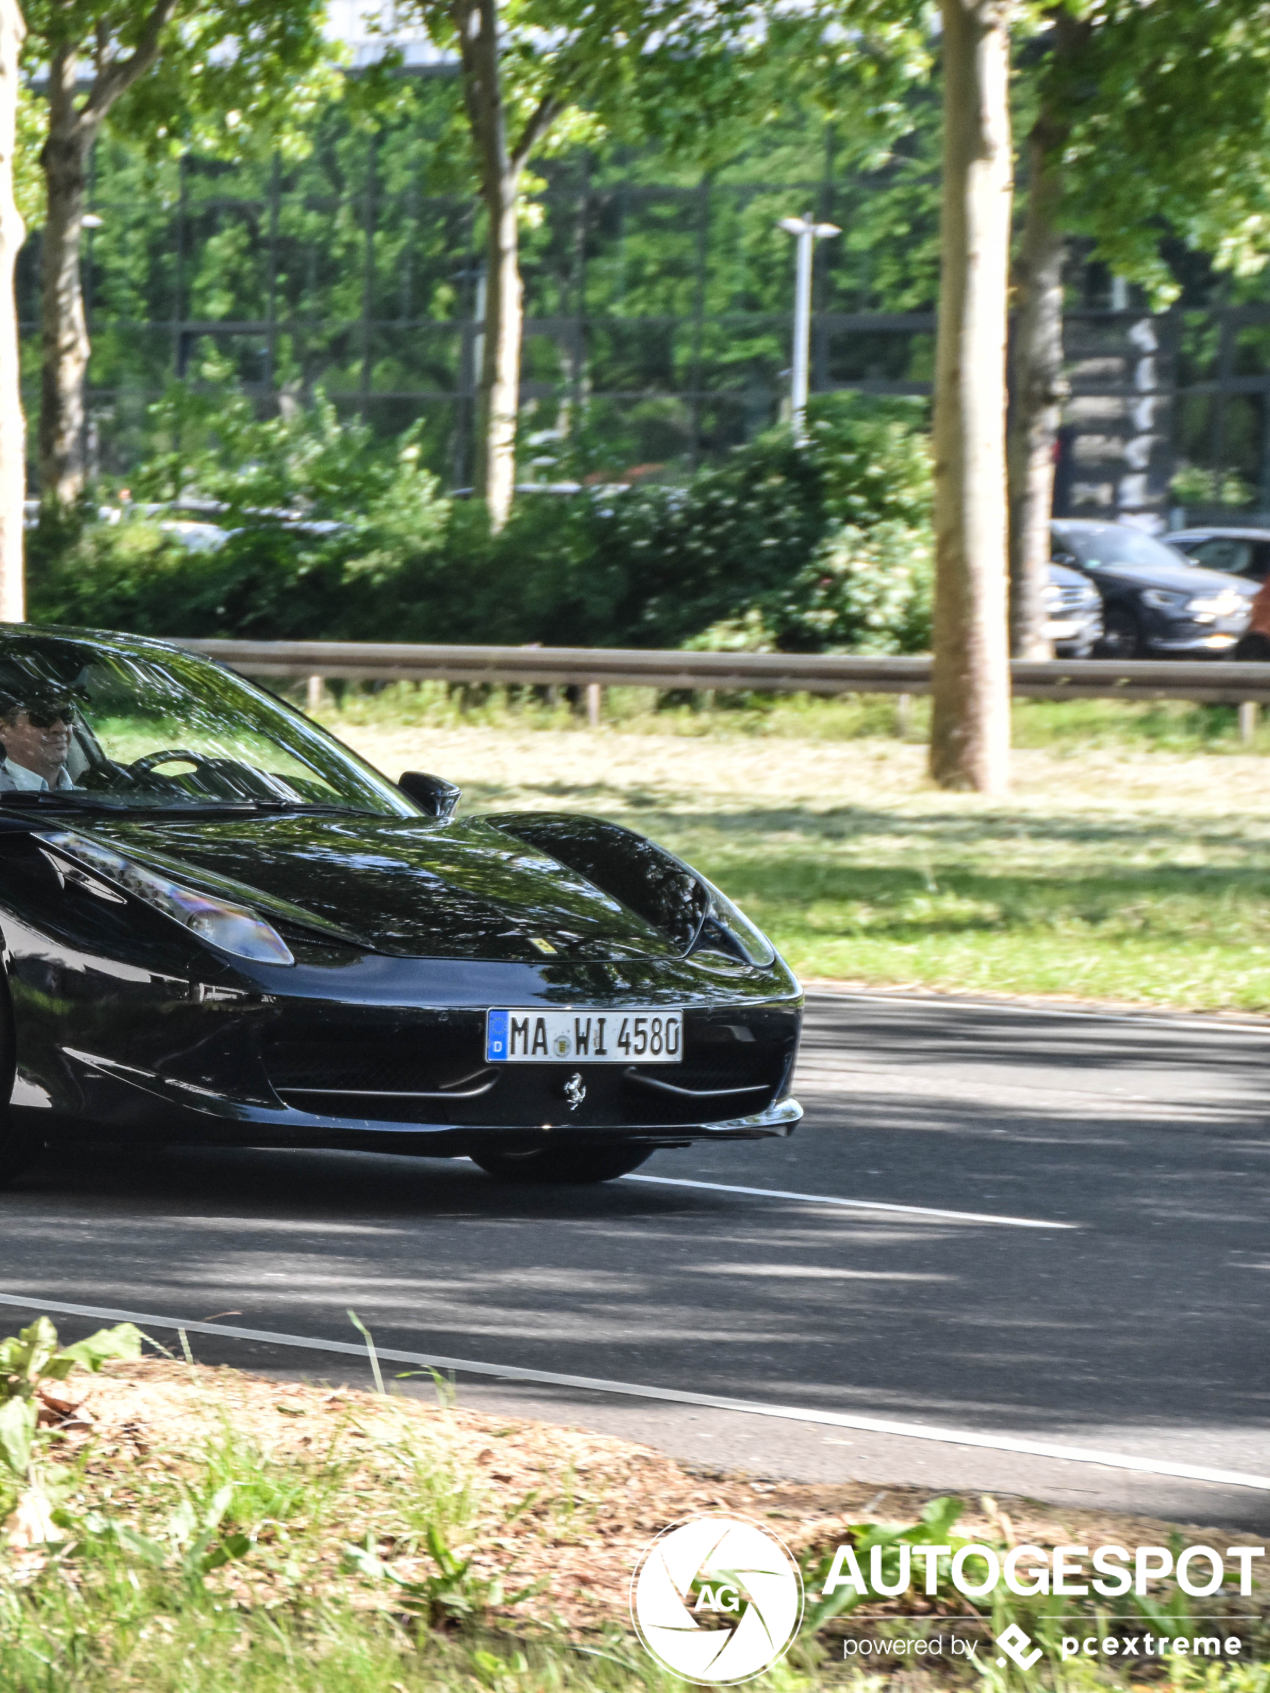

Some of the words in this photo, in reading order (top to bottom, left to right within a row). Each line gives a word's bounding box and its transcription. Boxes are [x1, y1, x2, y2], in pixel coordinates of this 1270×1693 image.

[493, 1041, 503, 1053] D
[510, 1017, 548, 1056] MA
[575, 1017, 607, 1056] WI
[617, 1017, 680, 1056] 4580
